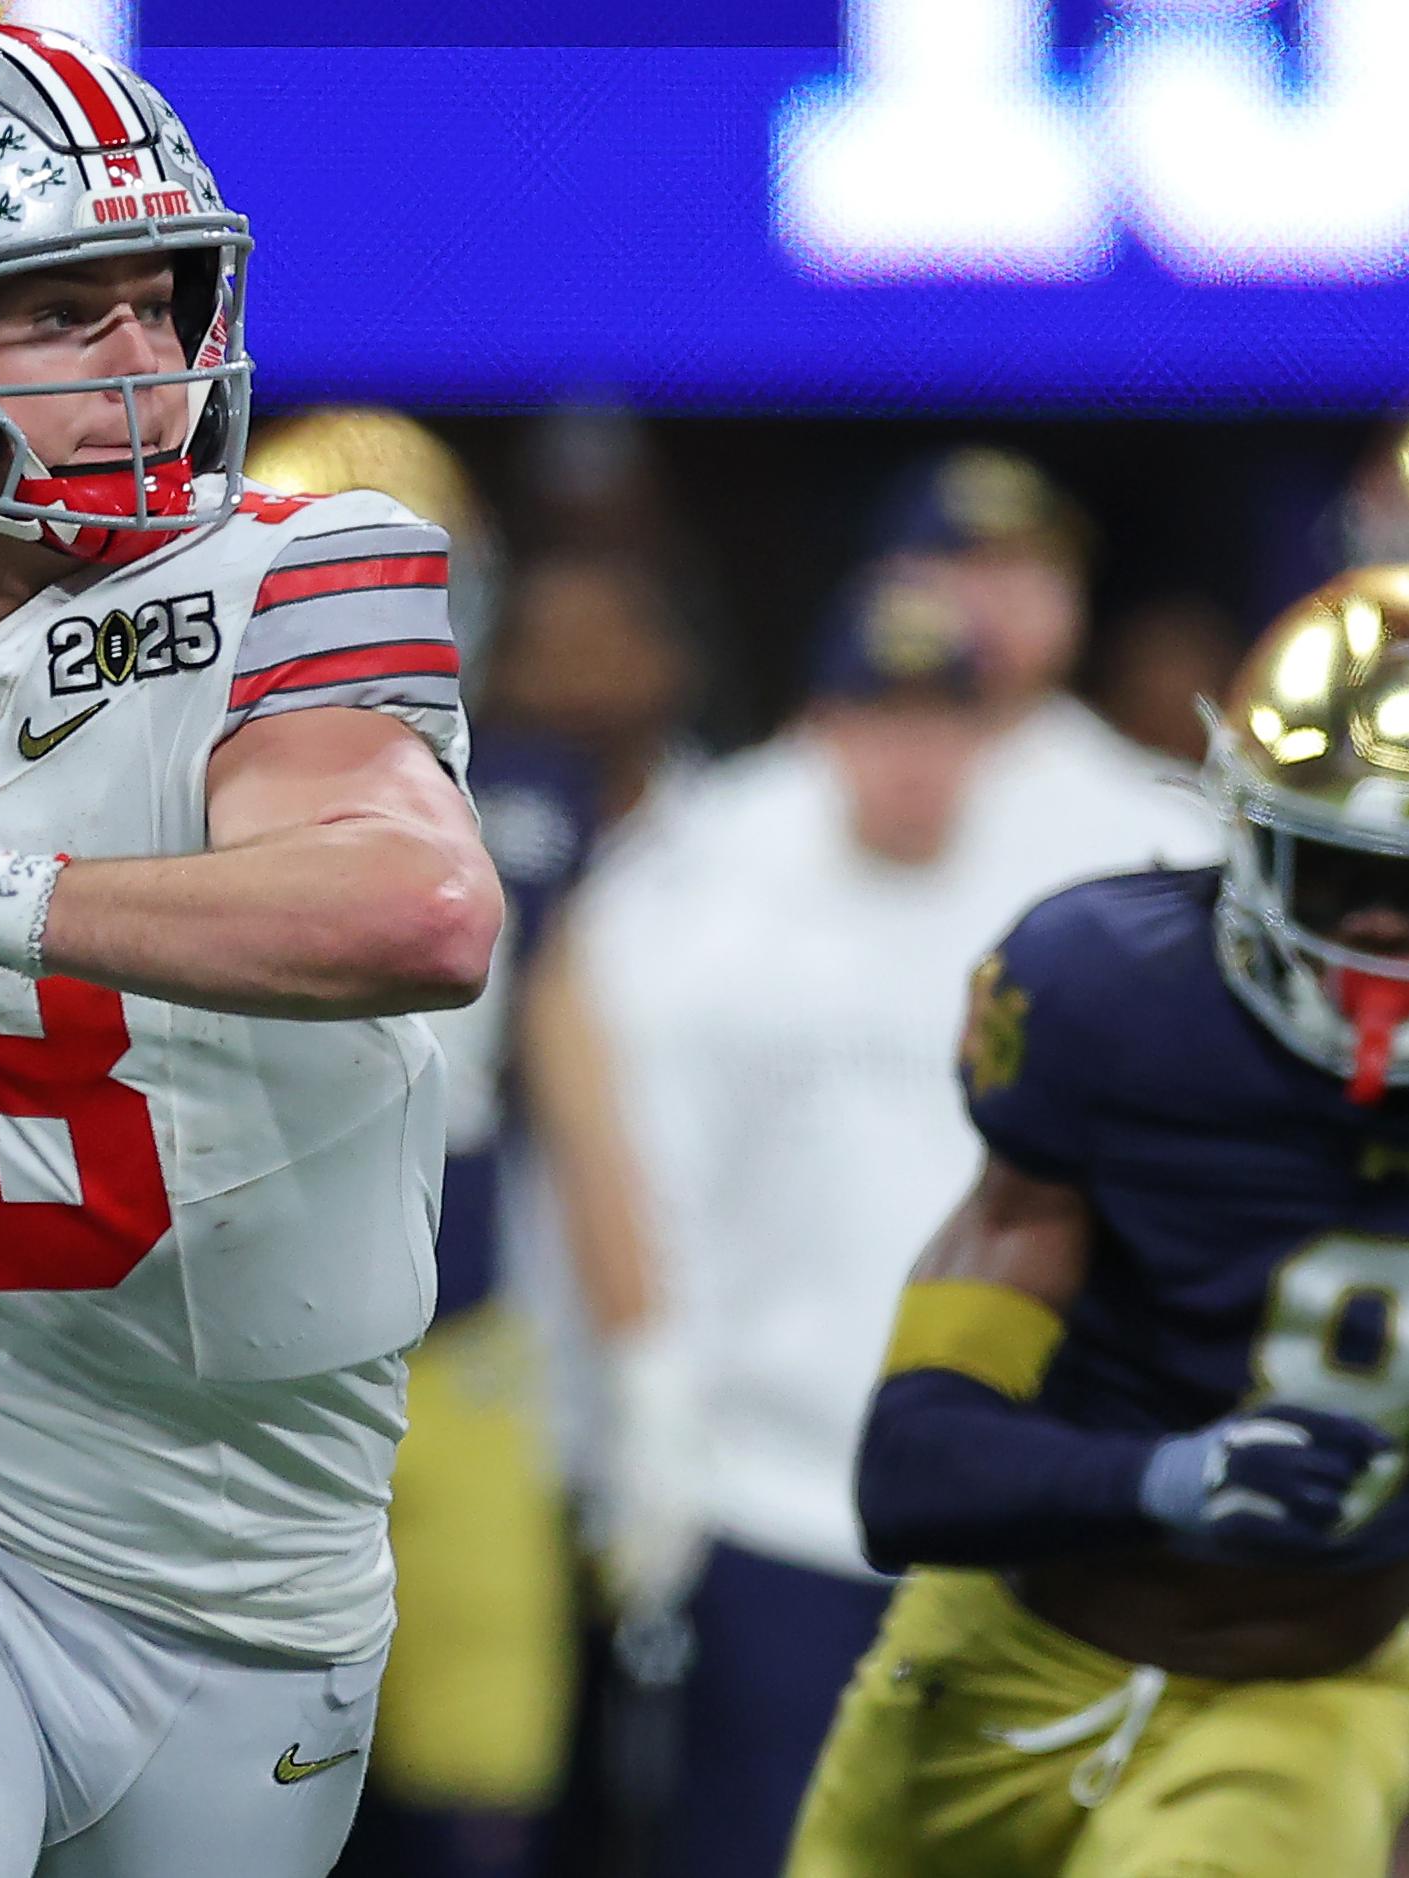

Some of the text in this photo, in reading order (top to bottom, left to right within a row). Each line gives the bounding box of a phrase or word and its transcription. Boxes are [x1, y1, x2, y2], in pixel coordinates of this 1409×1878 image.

[92, 190, 191, 224] OHIO STATE
[47, 591, 221, 698] 2025
